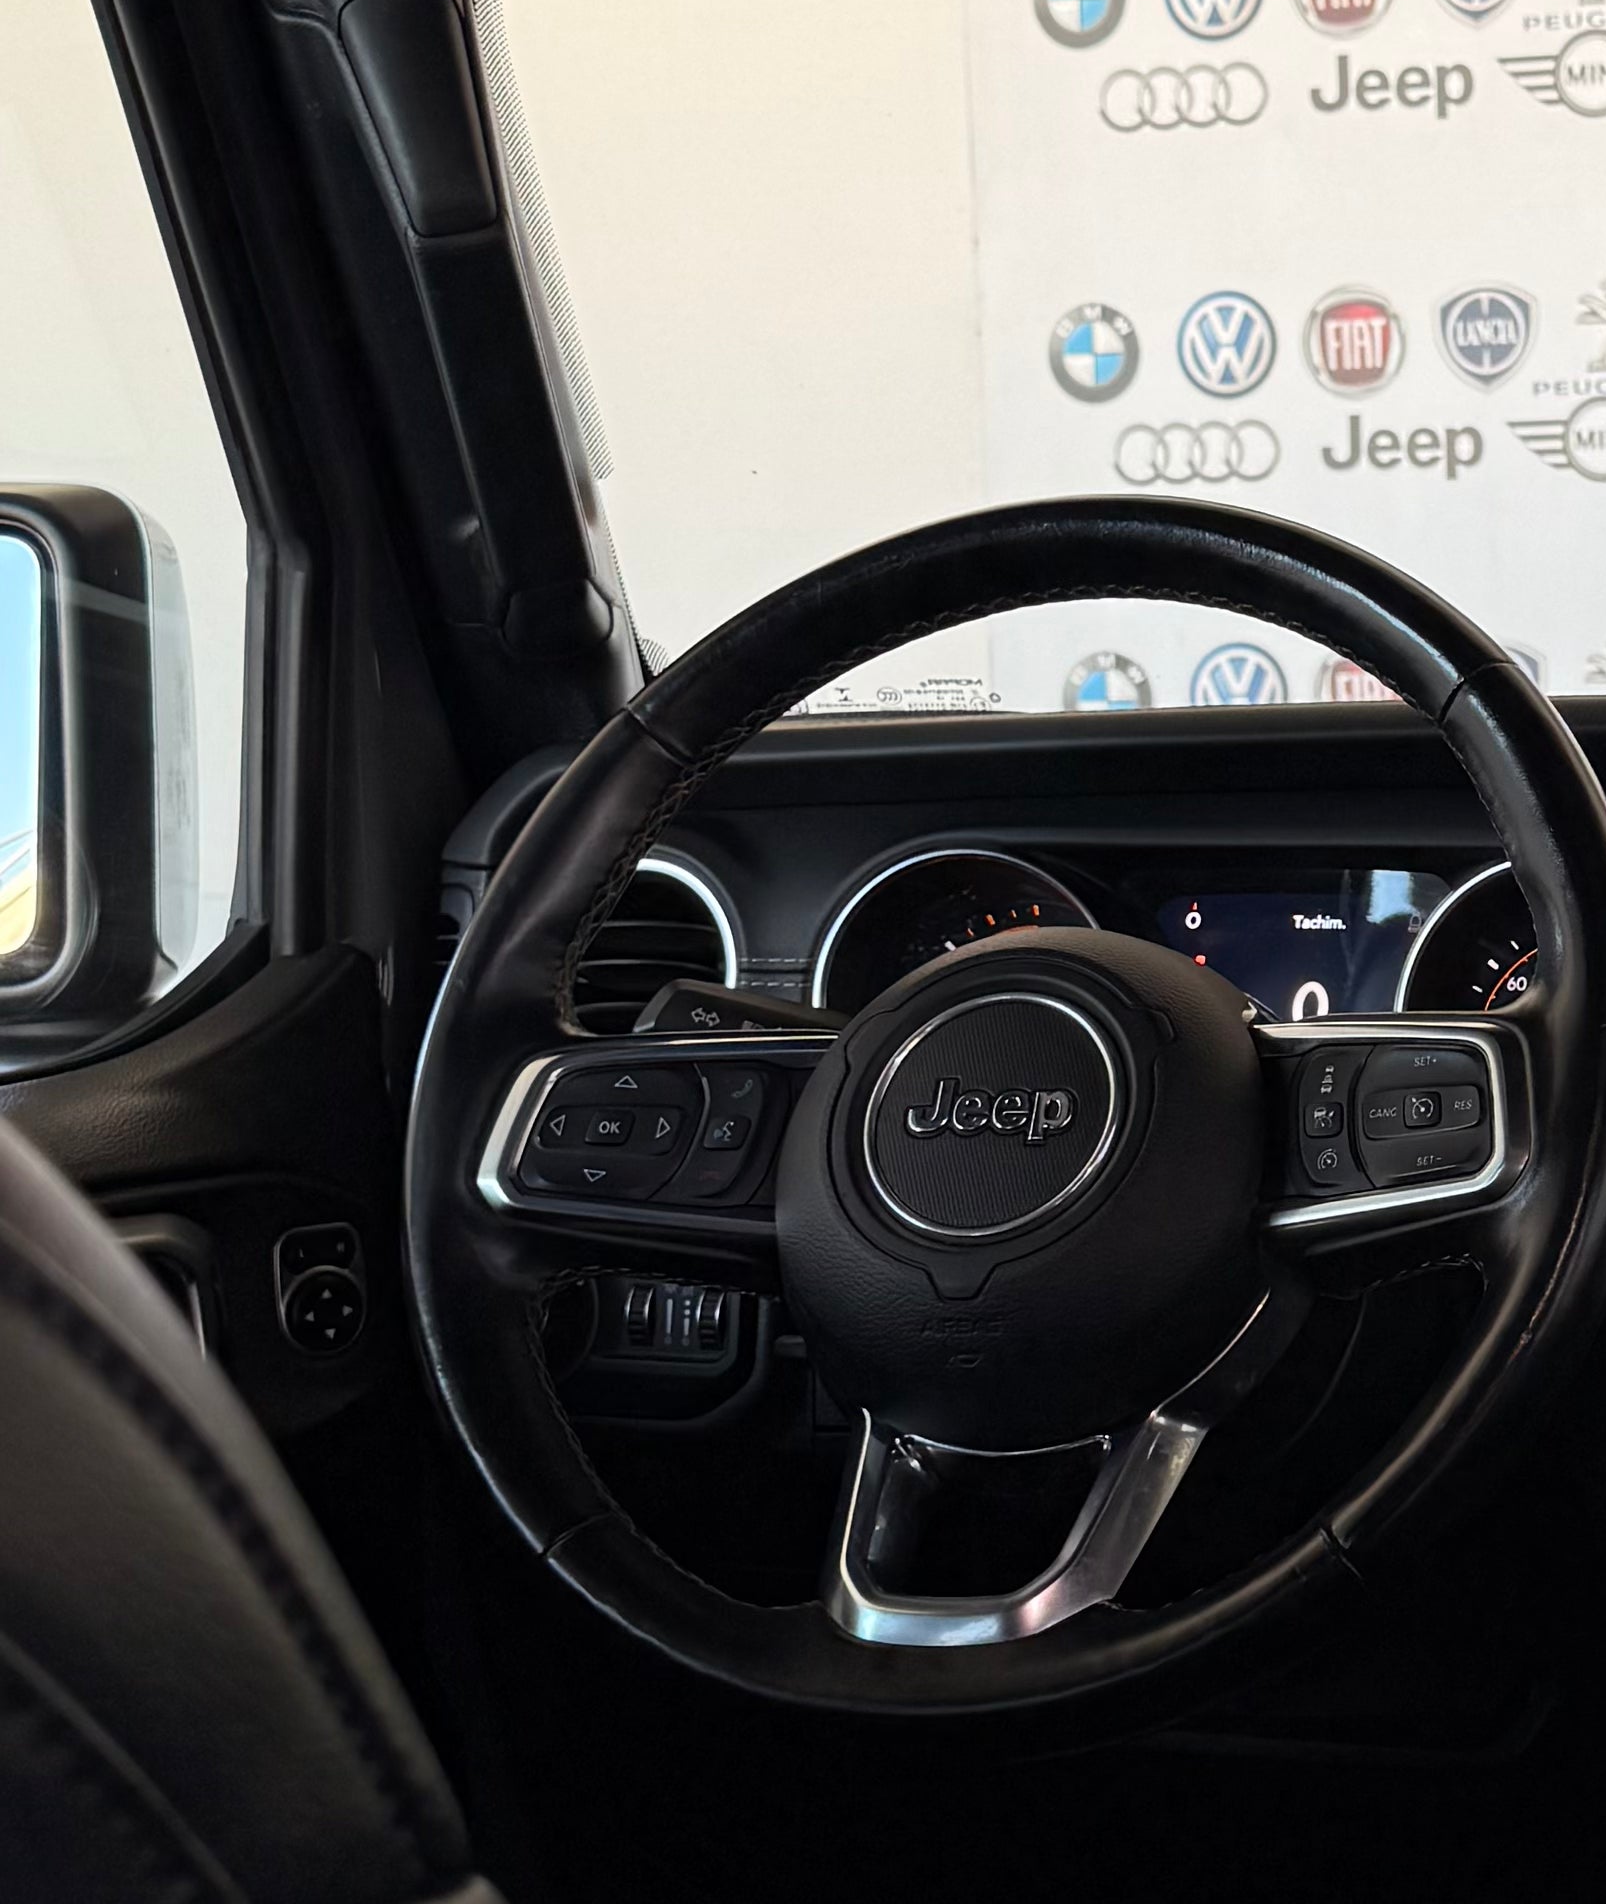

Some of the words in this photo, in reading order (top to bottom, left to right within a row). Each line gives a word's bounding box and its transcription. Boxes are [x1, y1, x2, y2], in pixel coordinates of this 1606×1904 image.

[1310, 54, 1475, 119] Jeep
[1323, 317, 1388, 372] FIAT
[1321, 414, 1484, 480] Jeep
[1291, 913, 1347, 931] Tachim.
[1506, 976, 1528, 992] 60
[905, 1077, 1079, 1146] Jeep
[1454, 1099, 1473, 1111] RES
[599, 1120, 621, 1134] OK
